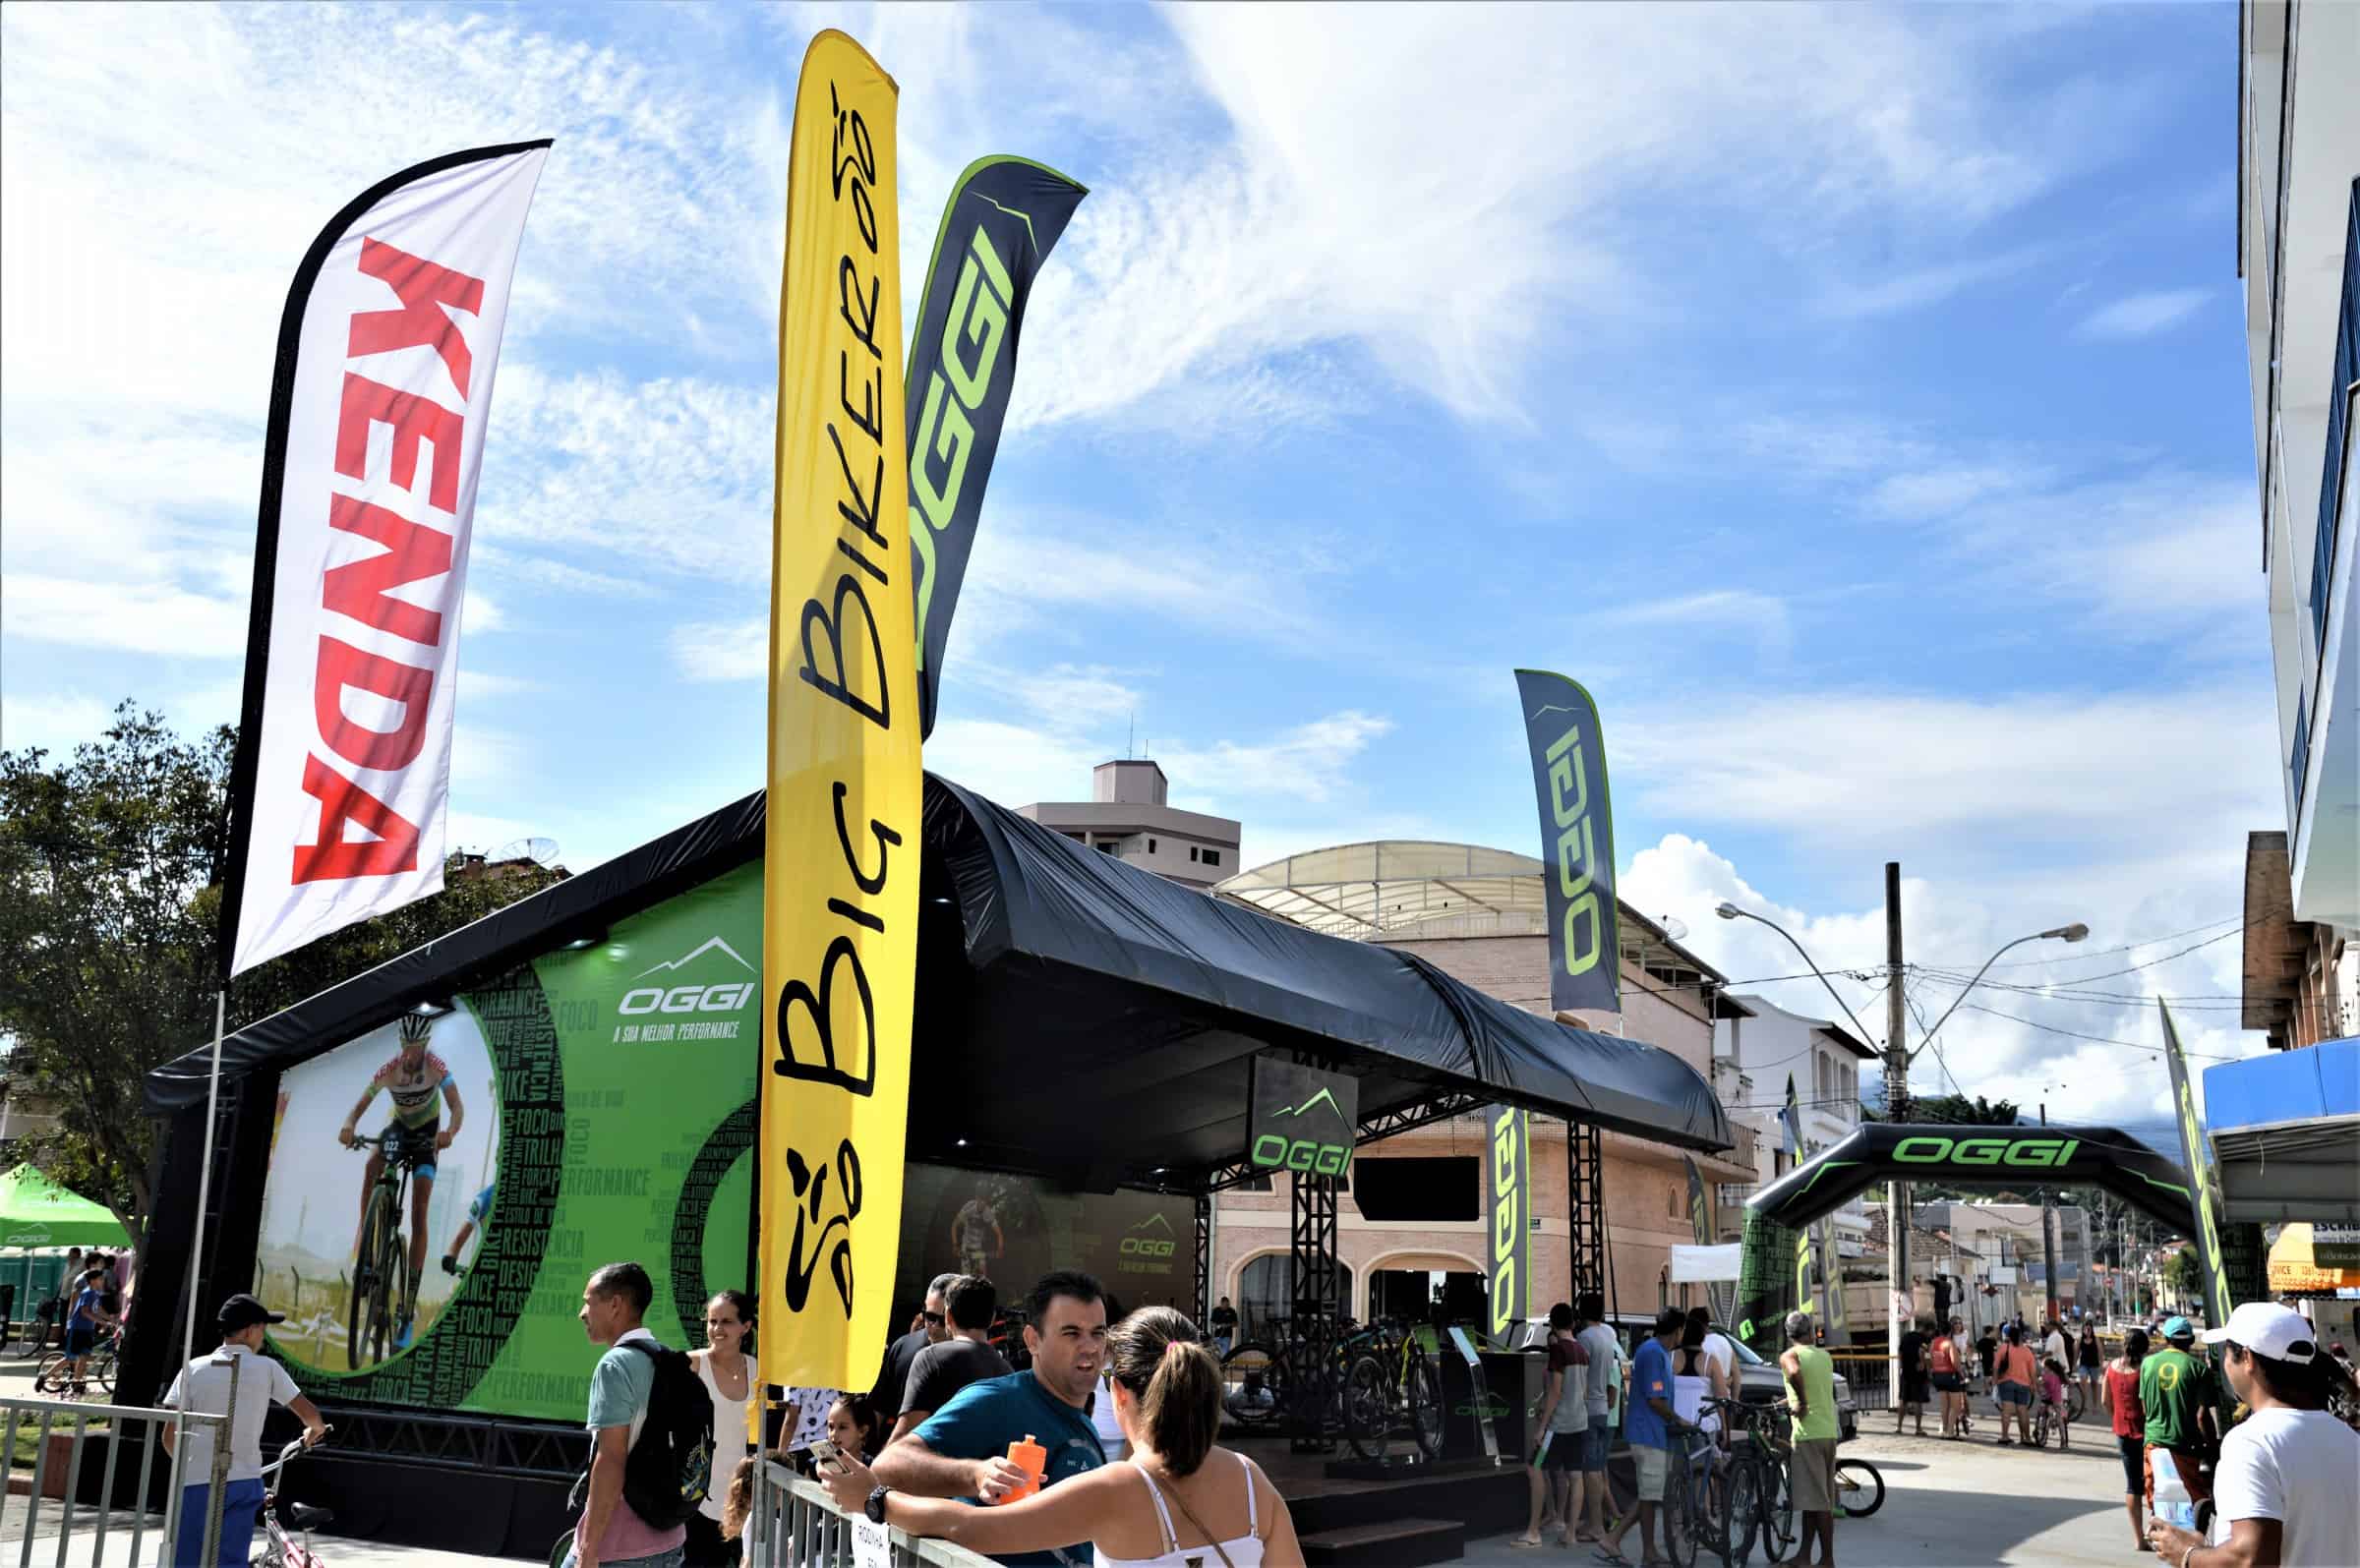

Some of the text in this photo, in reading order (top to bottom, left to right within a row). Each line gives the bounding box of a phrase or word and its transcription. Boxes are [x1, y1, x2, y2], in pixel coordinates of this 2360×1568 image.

[291, 236, 485, 886] KENDA
[773, 782, 903, 1097] BIG
[619, 983, 755, 1015] OGGI
[614, 1020, 739, 1043] A SUA MELHOR PERFORMANCE
[500, 1070, 530, 1102] IKE
[516, 1109, 550, 1135] FOCO
[524, 1138, 561, 1166] TRILH
[1252, 1134, 1353, 1177] OGGI
[1892, 1137, 2079, 1166] OGGI
[480, 1229, 502, 1270] BIKE
[1120, 1238, 1175, 1256] OGGI
[458, 1307, 492, 1335] FOCO
[2158, 1362, 2178, 1391] 9
